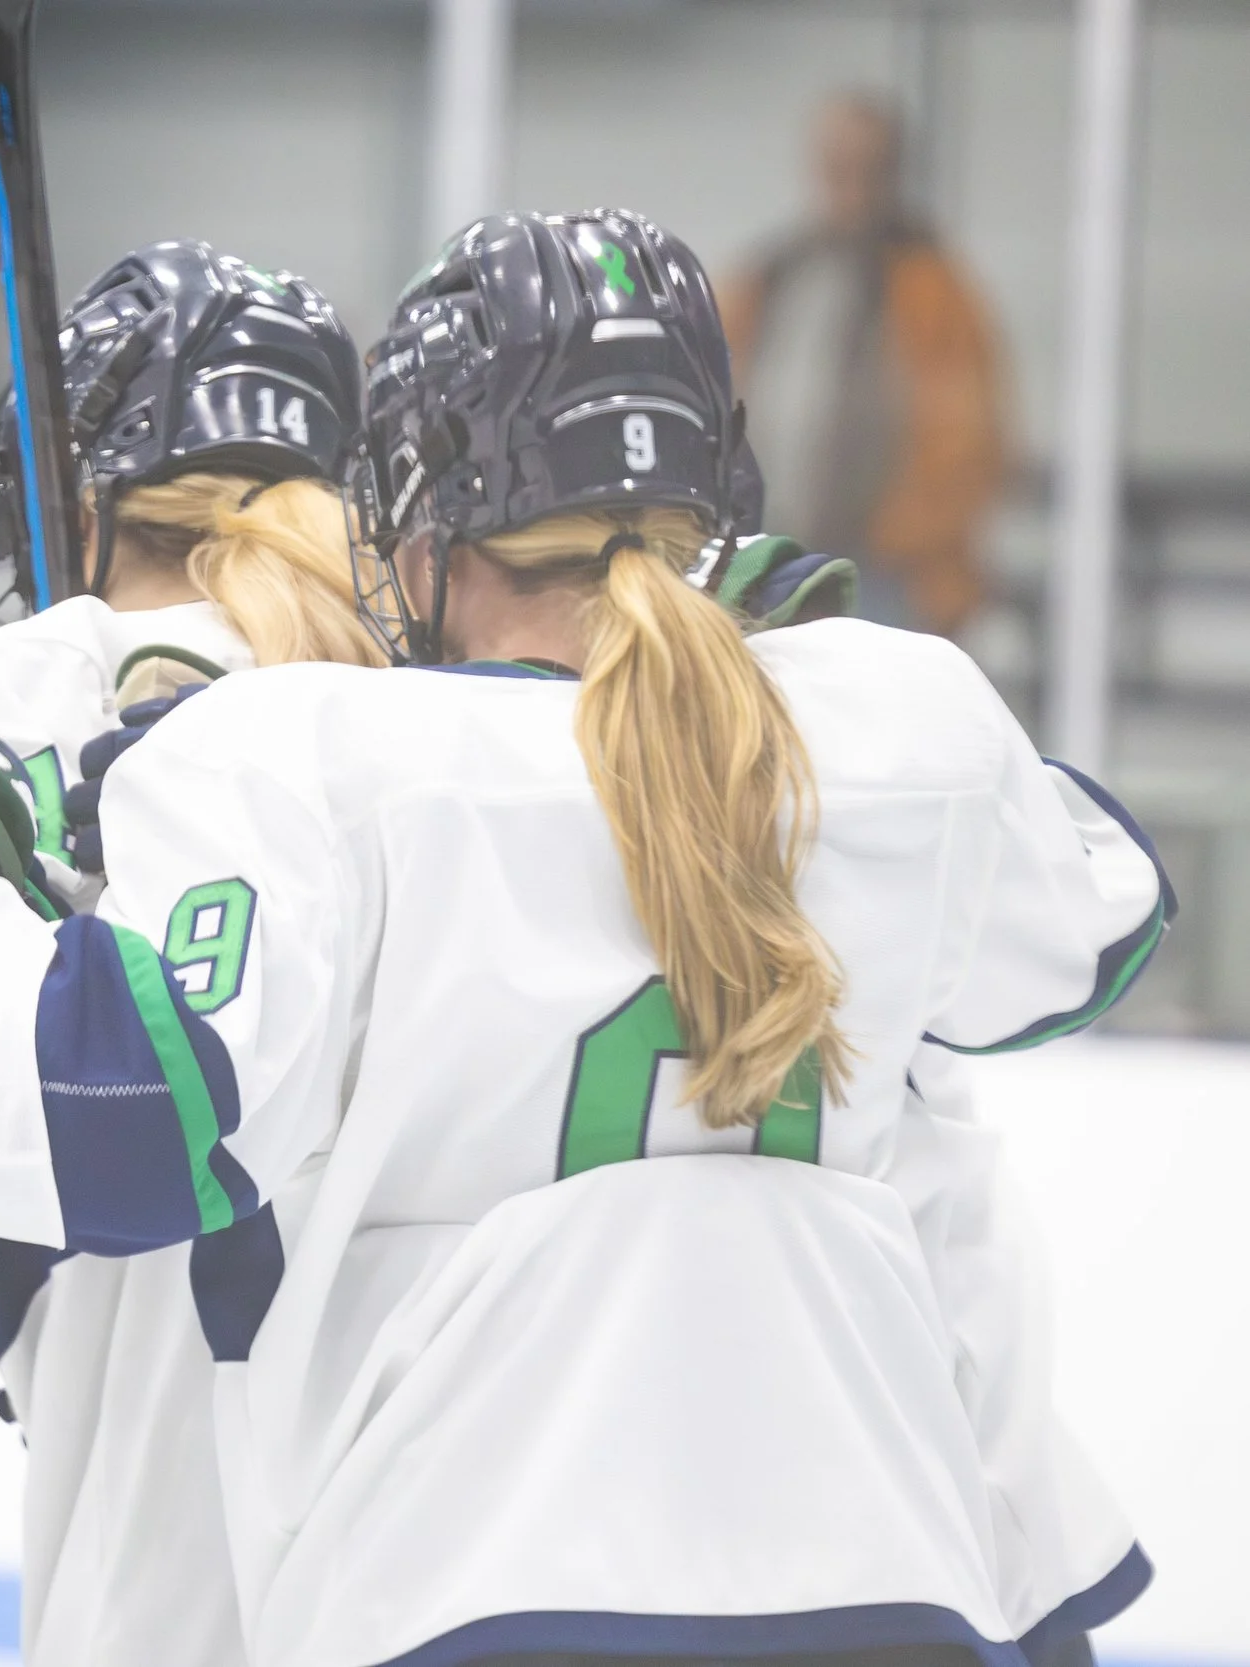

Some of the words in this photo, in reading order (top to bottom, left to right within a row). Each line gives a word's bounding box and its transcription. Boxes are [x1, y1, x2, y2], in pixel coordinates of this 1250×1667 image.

[256, 387, 309, 446] 14
[622, 412, 656, 473] 9
[163, 875, 258, 1016] 9
